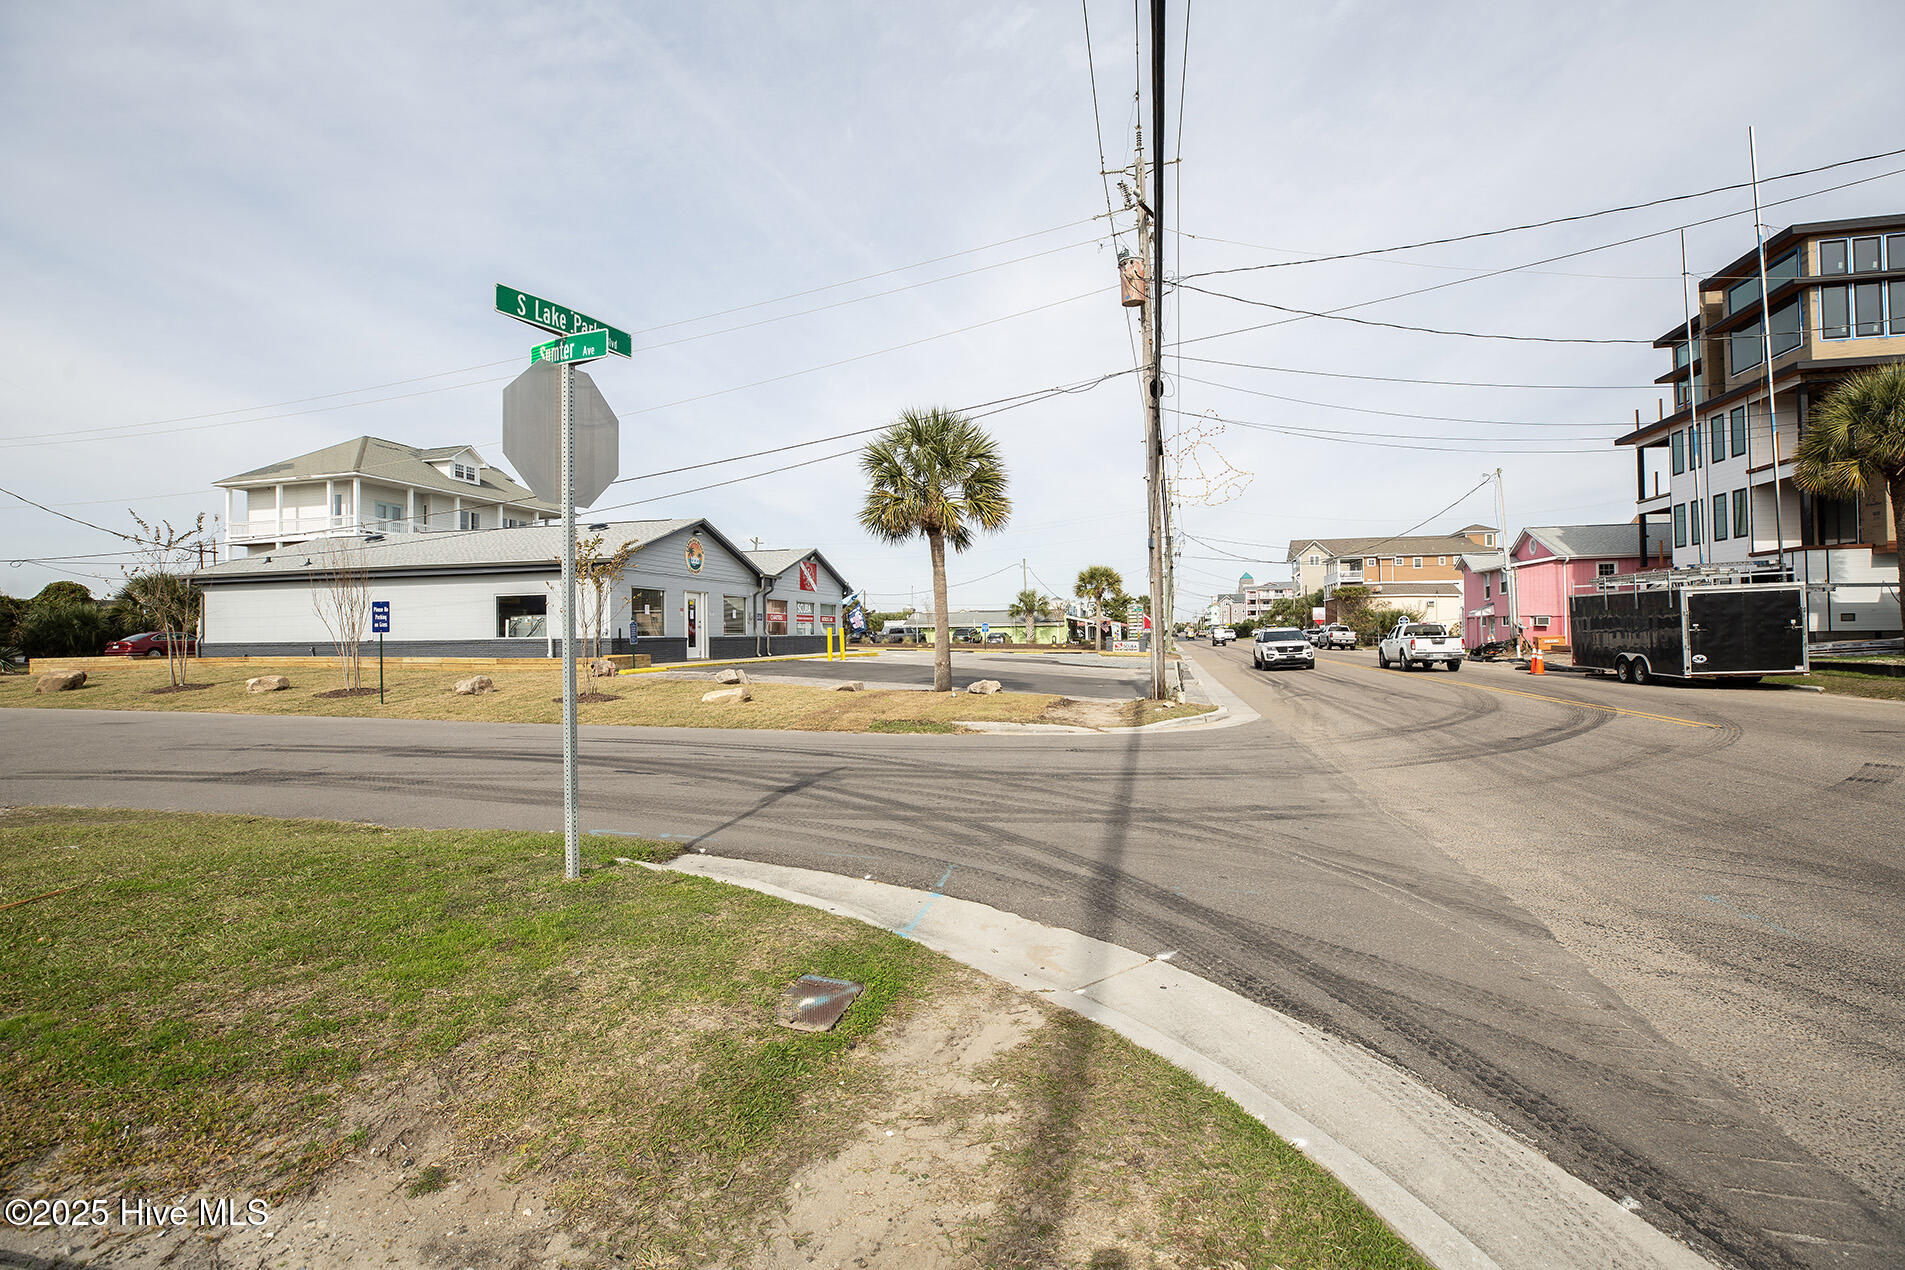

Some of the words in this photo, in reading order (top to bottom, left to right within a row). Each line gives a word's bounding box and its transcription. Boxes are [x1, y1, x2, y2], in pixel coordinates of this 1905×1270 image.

[517, 294, 527, 316] S
[535, 300, 567, 330] Lake
[539, 341, 575, 363] Sumter
[582, 345, 596, 357] Ave
